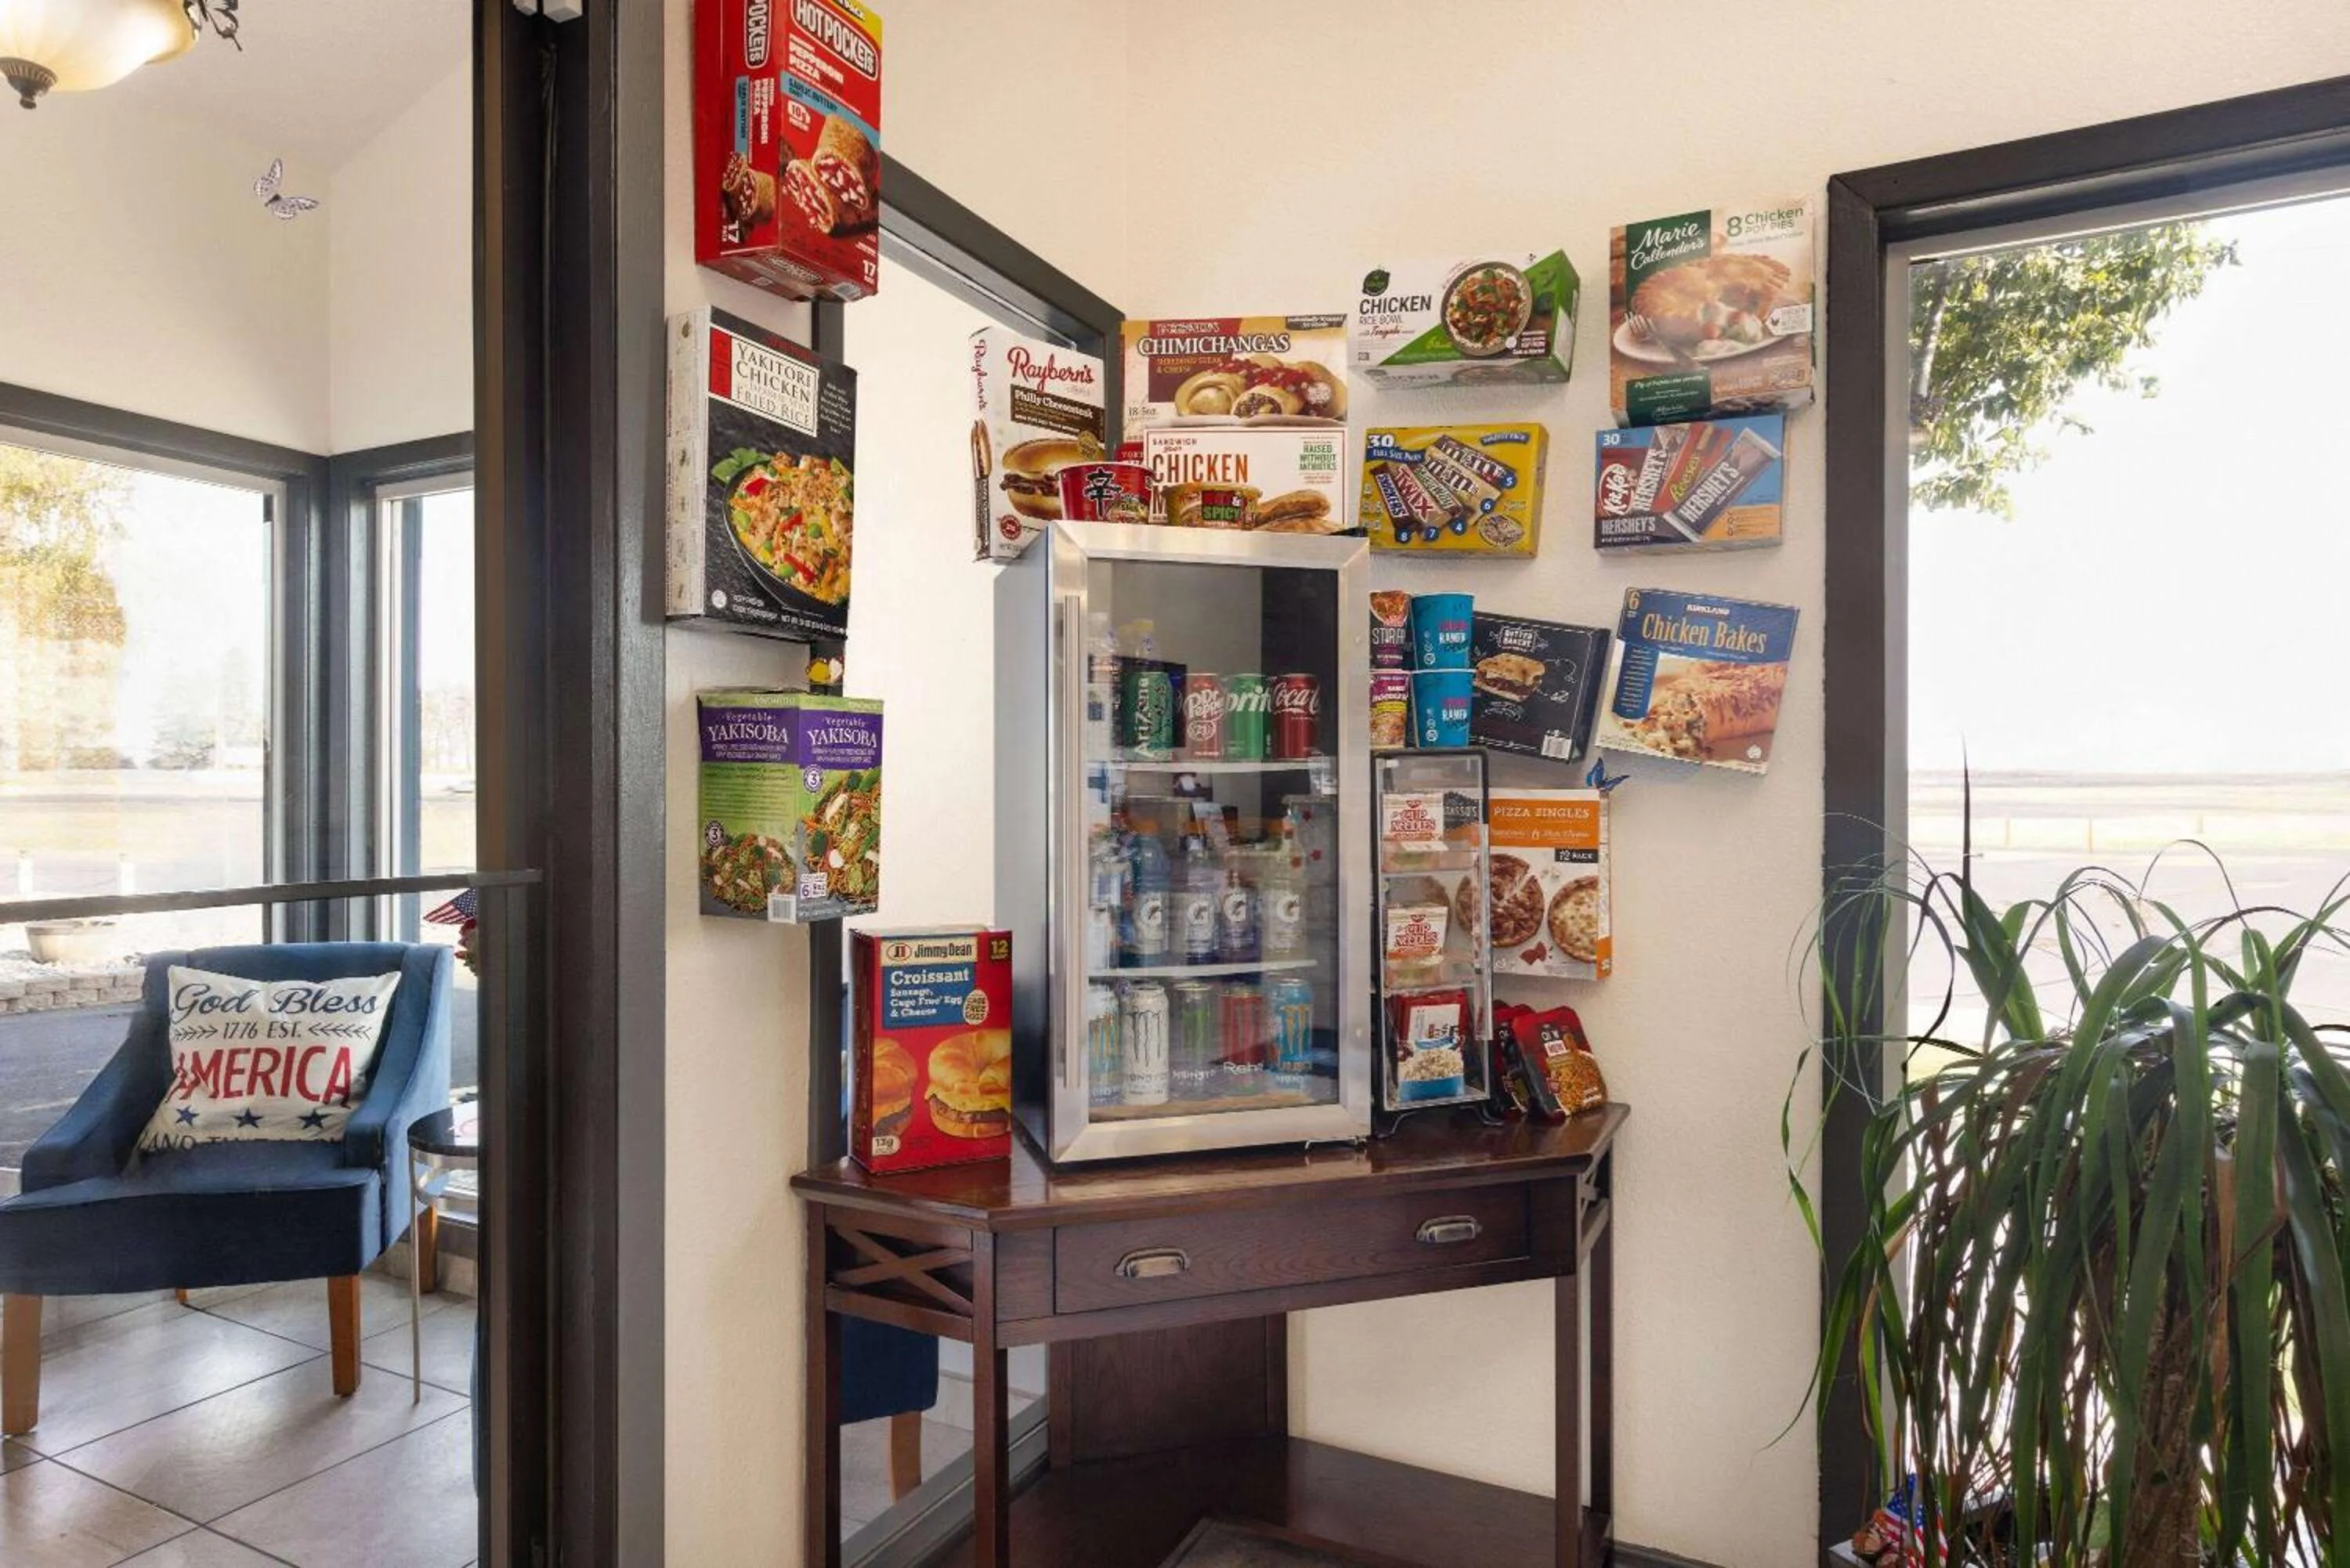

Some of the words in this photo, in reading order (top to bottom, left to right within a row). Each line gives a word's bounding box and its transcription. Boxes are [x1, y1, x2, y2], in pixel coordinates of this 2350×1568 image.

[748, 0, 768, 62] OCKETS
[795, 0, 822, 38] HOT
[824, 14, 874, 74] POCKETS
[1727, 215, 1742, 237] 8
[1745, 207, 1803, 225] Chicken
[1632, 222, 1700, 255] Marie
[1631, 241, 1706, 270] Callender's
[862, 259, 876, 276] 17
[1359, 294, 1432, 315] CHICKEN
[1137, 334, 1290, 356] CHIMICHANGAS
[738, 343, 811, 387] YAKITORI
[1007, 346, 1095, 391] Raybern's
[736, 360, 809, 403] CHICKEN
[737, 385, 776, 412] FRIED
[782, 404, 810, 426] RICE
[1014, 390, 1040, 406] Philly
[1368, 435, 1394, 447] 30
[1603, 434, 1620, 446] 30
[1152, 453, 1248, 483] CHICKEN
[1506, 477, 1513, 486] 5
[1083, 467, 1123, 519] 辛
[1679, 461, 1739, 522] HERSHEY'S
[1203, 506, 1240, 520] SPICY
[1484, 500, 1491, 509] 6
[1429, 529, 1436, 538] 7
[1455, 522, 1462, 531] 4
[1602, 517, 1655, 534] HERSHEY'S
[1401, 532, 1408, 540] 8
[1629, 591, 1640, 610] 6
[1642, 613, 1709, 646] Chicken
[1715, 621, 1766, 654] Bakes
[725, 712, 773, 721] Vegetable
[707, 723, 790, 744] YAKISOBA
[807, 727, 877, 747] YAKISOBA
[809, 774, 817, 786] 3
[1494, 807, 1530, 817] PIZZA
[1535, 807, 1589, 818] SINGLES
[1390, 819, 1435, 832] NOODLES
[710, 829, 718, 840] 3
[1560, 851, 1571, 861] 12
[801, 884, 809, 896] 6
[991, 940, 1008, 954] 12
[1395, 932, 1438, 946] NOODLES
[914, 944, 948, 958] Jimmy
[949, 943, 972, 956] Dean
[891, 968, 970, 985] Croissant
[172, 983, 259, 1024] God
[268, 987, 378, 1015] Bless
[901, 1008, 938, 1017] Cheese
[223, 1021, 257, 1039] 1776
[267, 1021, 302, 1039] EST.
